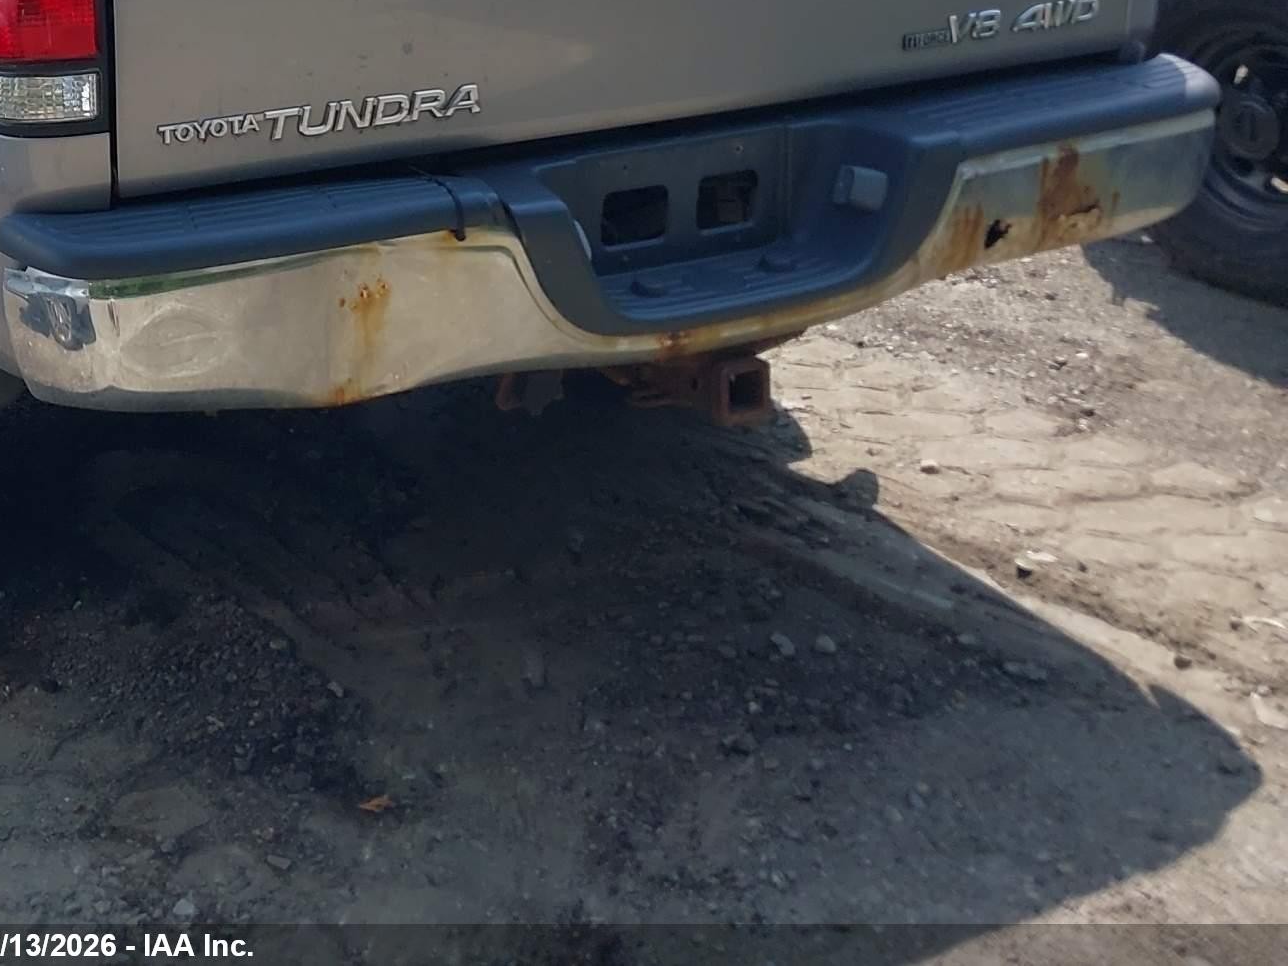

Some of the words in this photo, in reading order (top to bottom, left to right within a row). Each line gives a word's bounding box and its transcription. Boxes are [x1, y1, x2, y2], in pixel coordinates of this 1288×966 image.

[949, 8, 1002, 44] V8
[158, 113, 261, 145] TOYOTA
[263, 82, 481, 141] TUNDRA
